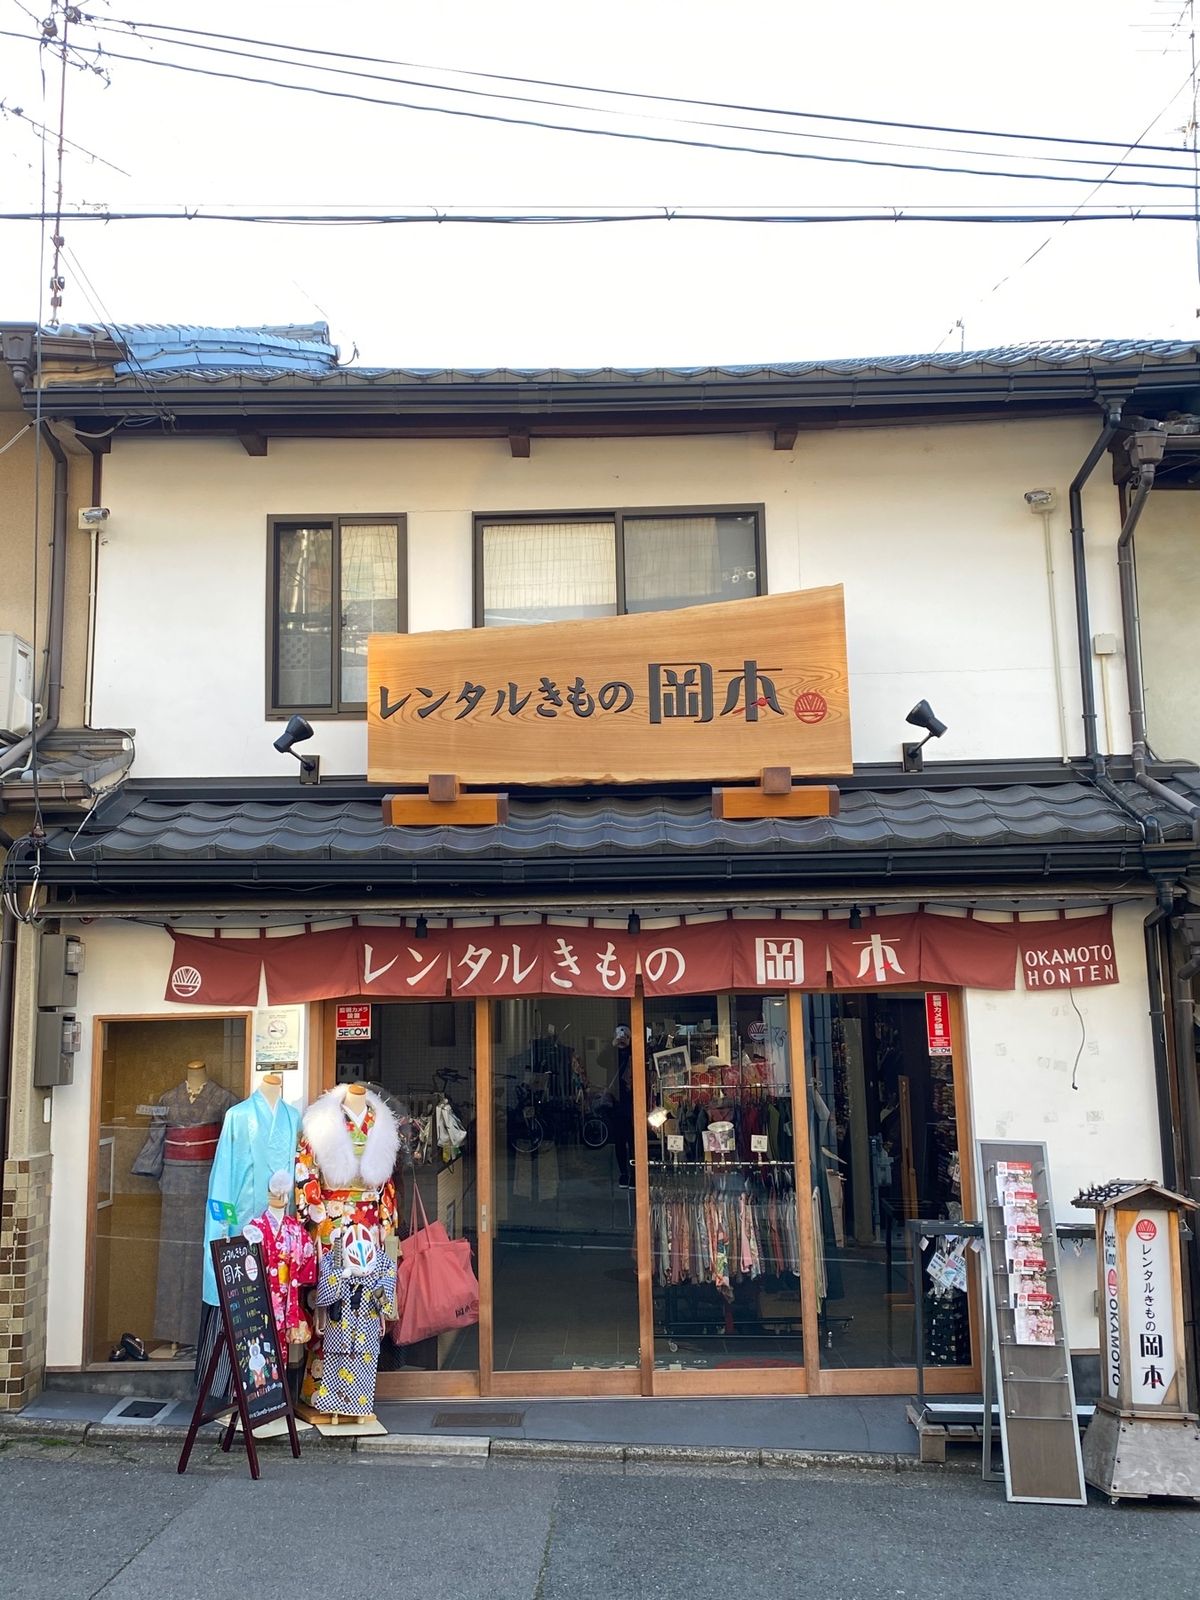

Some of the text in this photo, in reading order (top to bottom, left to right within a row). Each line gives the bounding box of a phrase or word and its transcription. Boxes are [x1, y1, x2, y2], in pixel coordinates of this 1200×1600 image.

[378, 660, 785, 724] レンタルきもの岡本
[1025, 944, 1112, 967] OKAMOTO
[1027, 964, 1114, 986] HONTEN
[338, 1028, 369, 1036] SECOM
[1109, 1298, 1121, 1386] OKAMOTO
